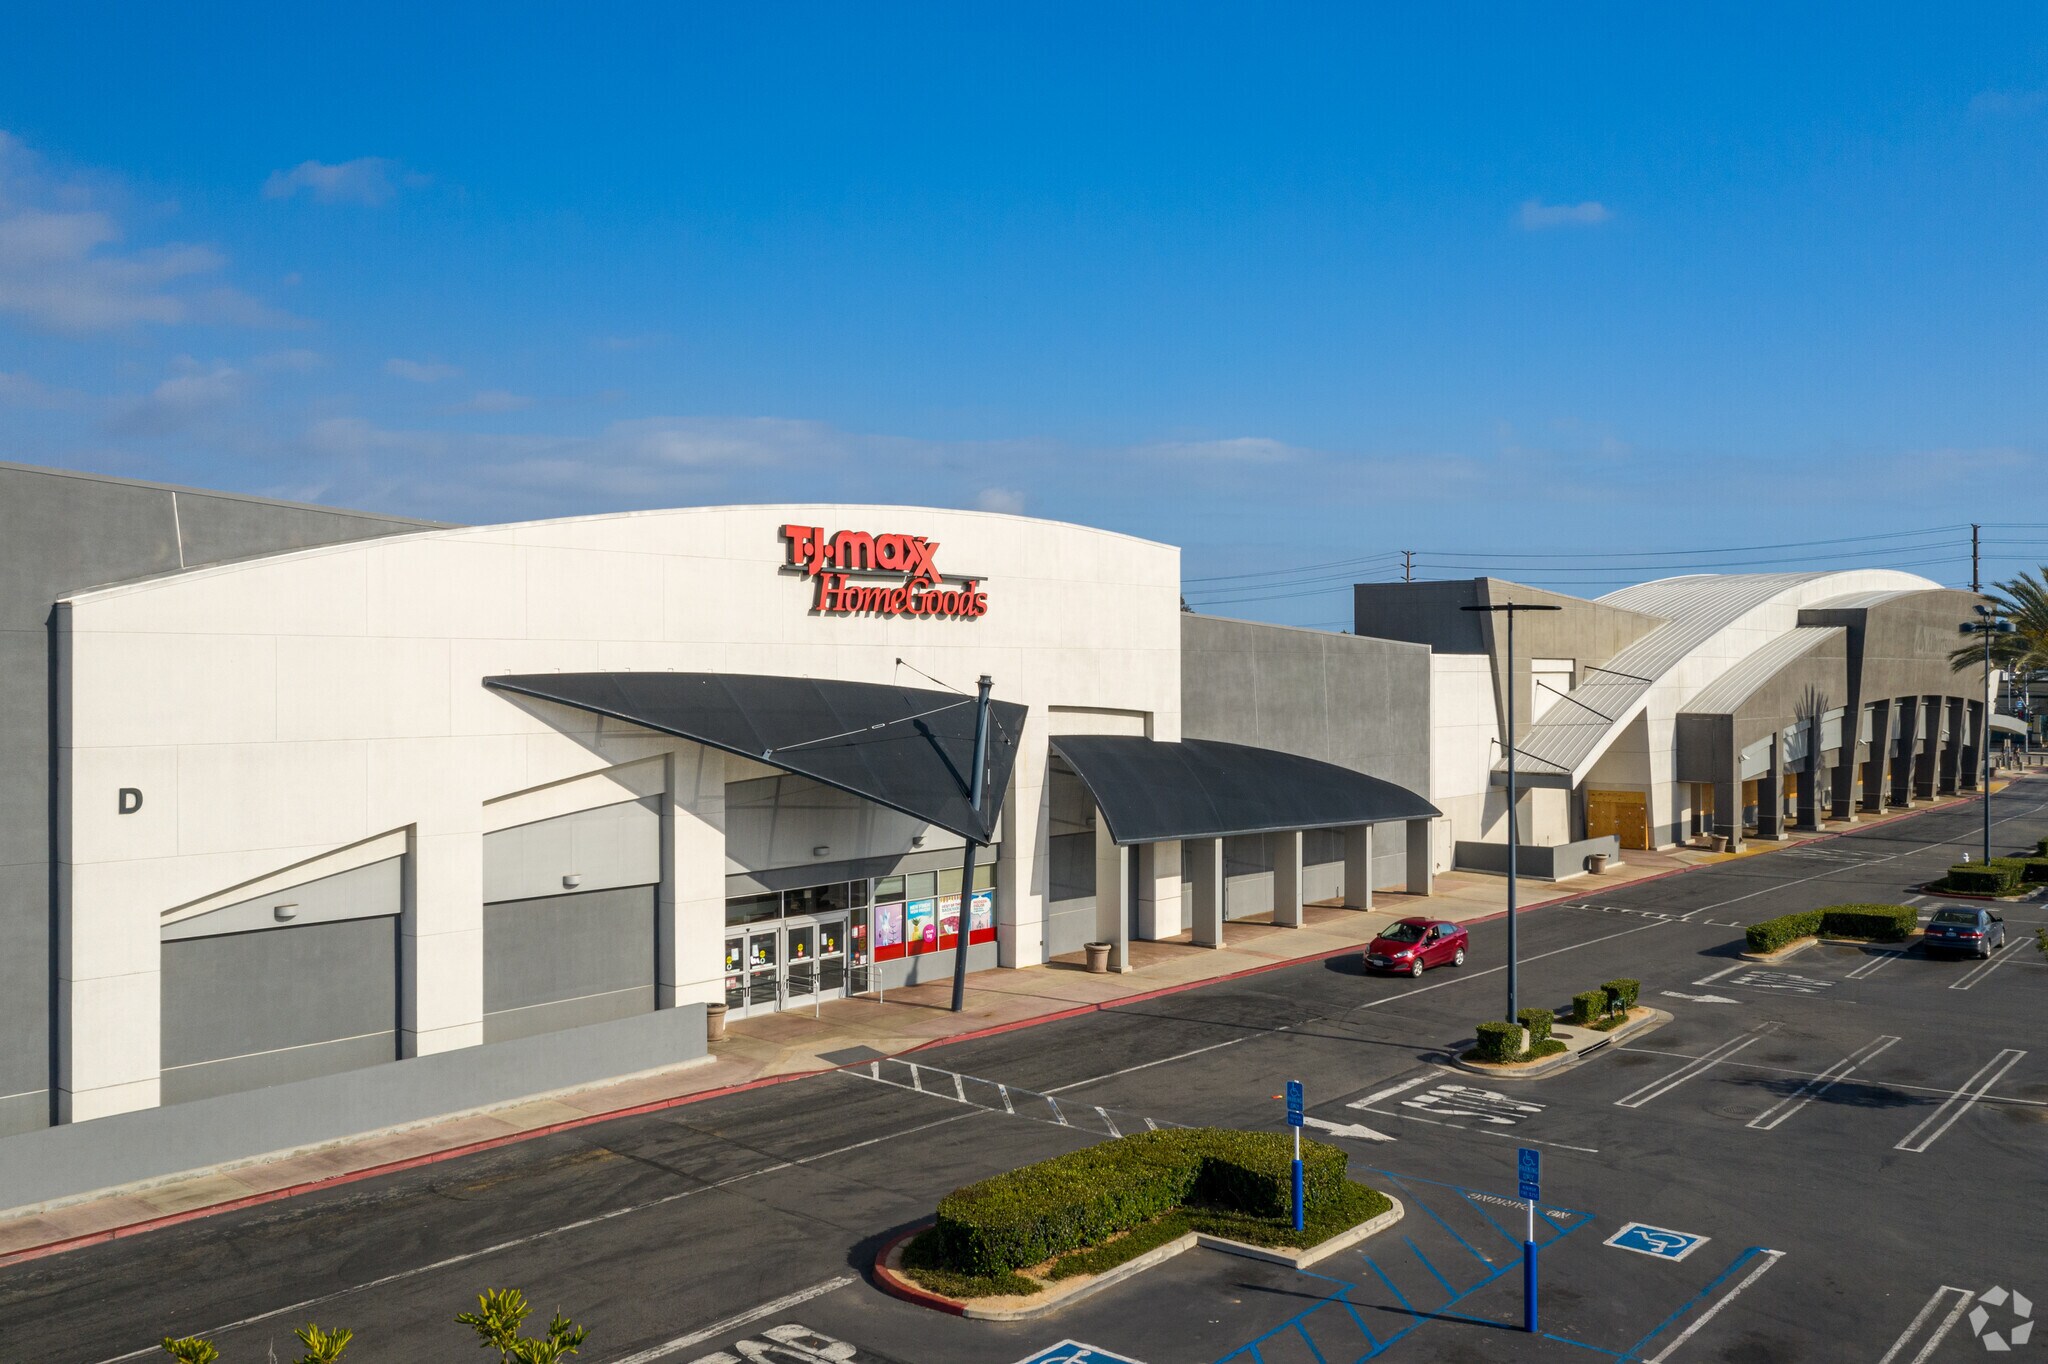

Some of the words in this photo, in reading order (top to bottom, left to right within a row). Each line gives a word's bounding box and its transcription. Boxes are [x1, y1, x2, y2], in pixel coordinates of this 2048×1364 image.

[816, 572, 988, 617] HomeGoods
[118, 787, 144, 815] D
[1400, 1084, 1547, 1125] STOP
